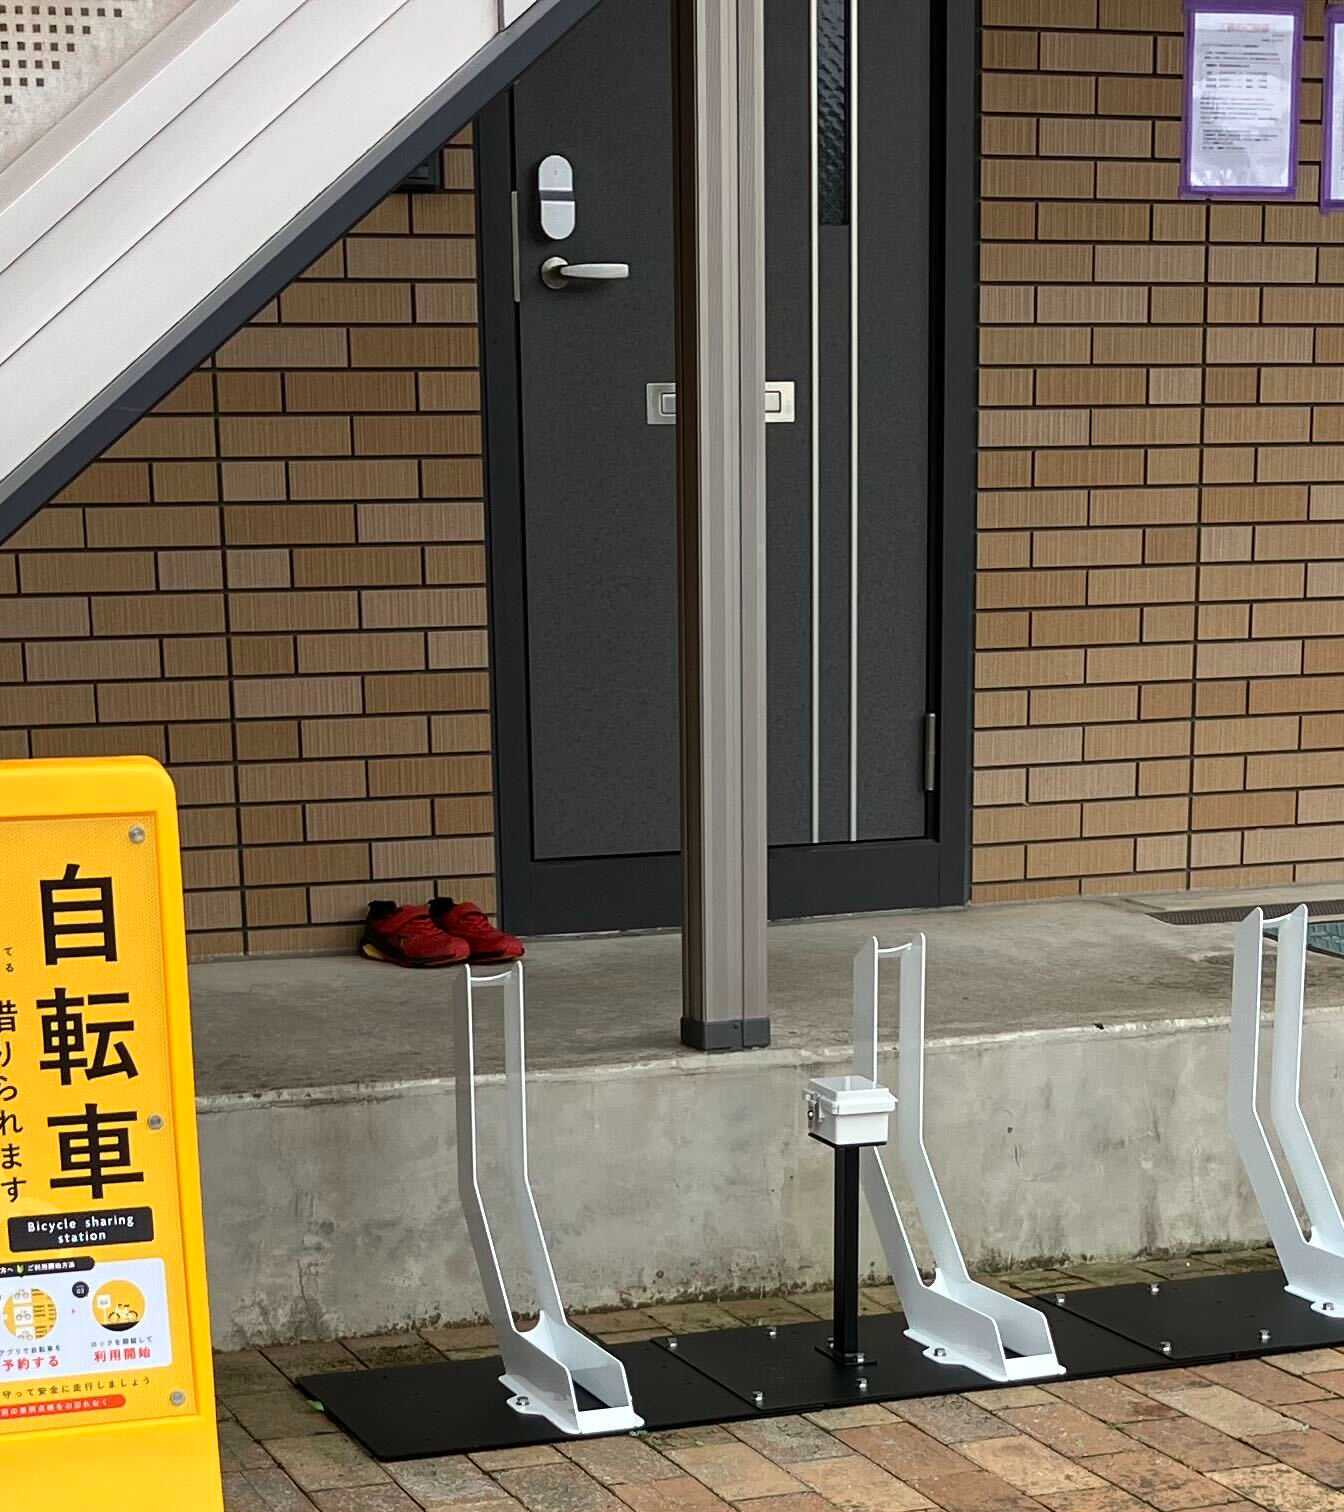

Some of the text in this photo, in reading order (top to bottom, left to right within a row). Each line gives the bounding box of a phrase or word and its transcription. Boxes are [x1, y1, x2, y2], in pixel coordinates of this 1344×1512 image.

[36, 863, 144, 1200] 自転車
[27, 1214, 135, 1233] Bicycle sharing
[57, 1231, 106, 1244] station
[2, 1355, 59, 1371] 予約する
[93, 1345, 151, 1363] 利用開始
